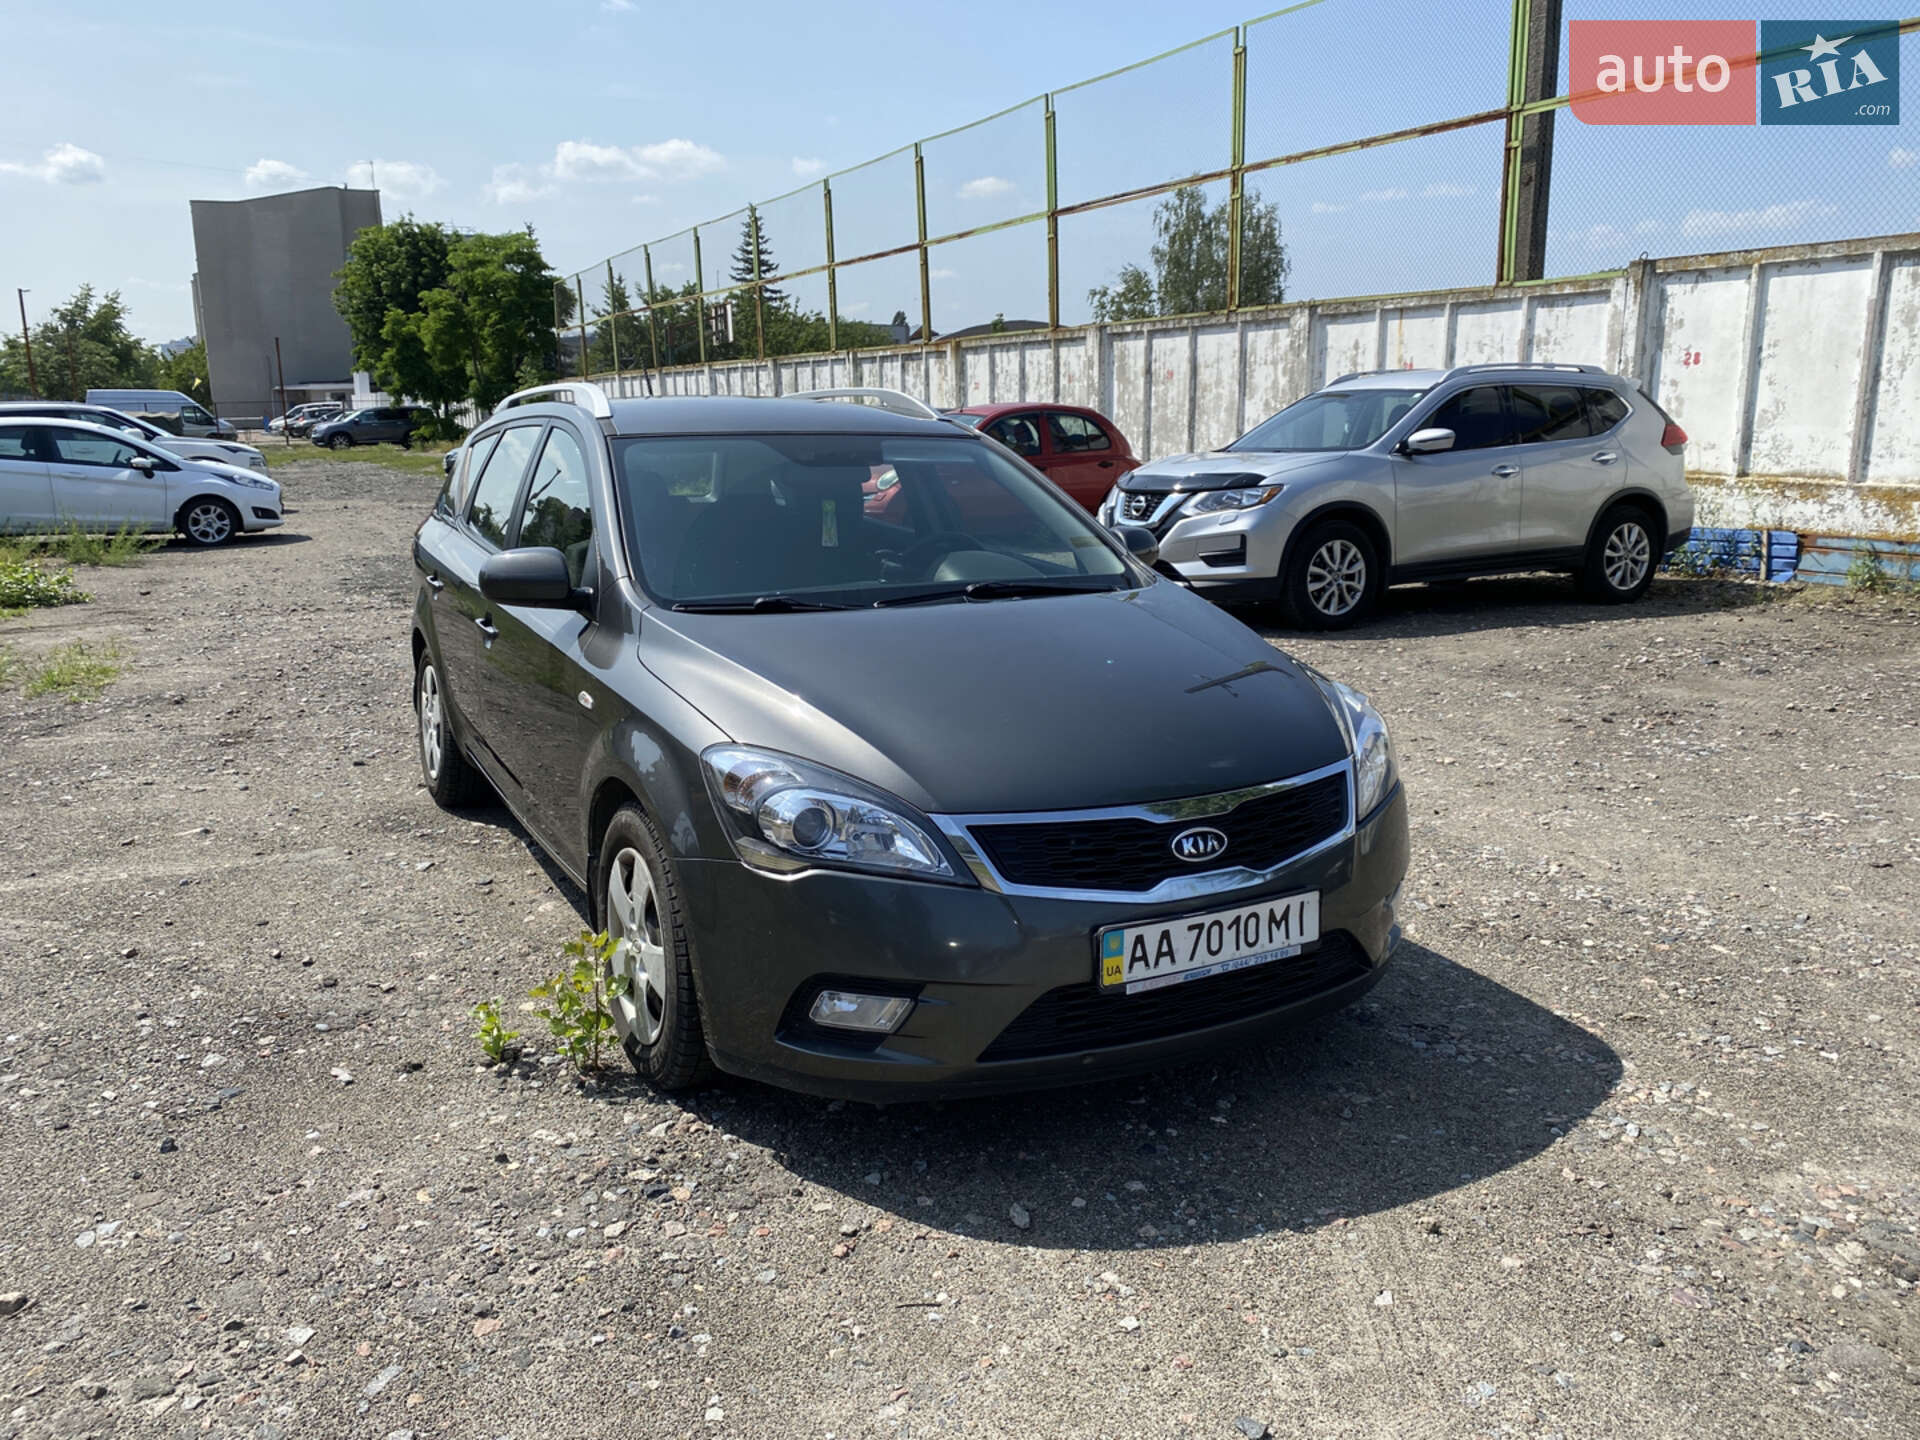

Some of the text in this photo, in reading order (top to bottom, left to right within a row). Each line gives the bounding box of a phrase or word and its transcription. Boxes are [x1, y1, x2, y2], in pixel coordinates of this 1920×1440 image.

[1181, 834, 1220, 856] KIA
[1128, 929, 1176, 974] AA
[1187, 911, 1260, 962] 7010
[1106, 965, 1122, 977] UA
